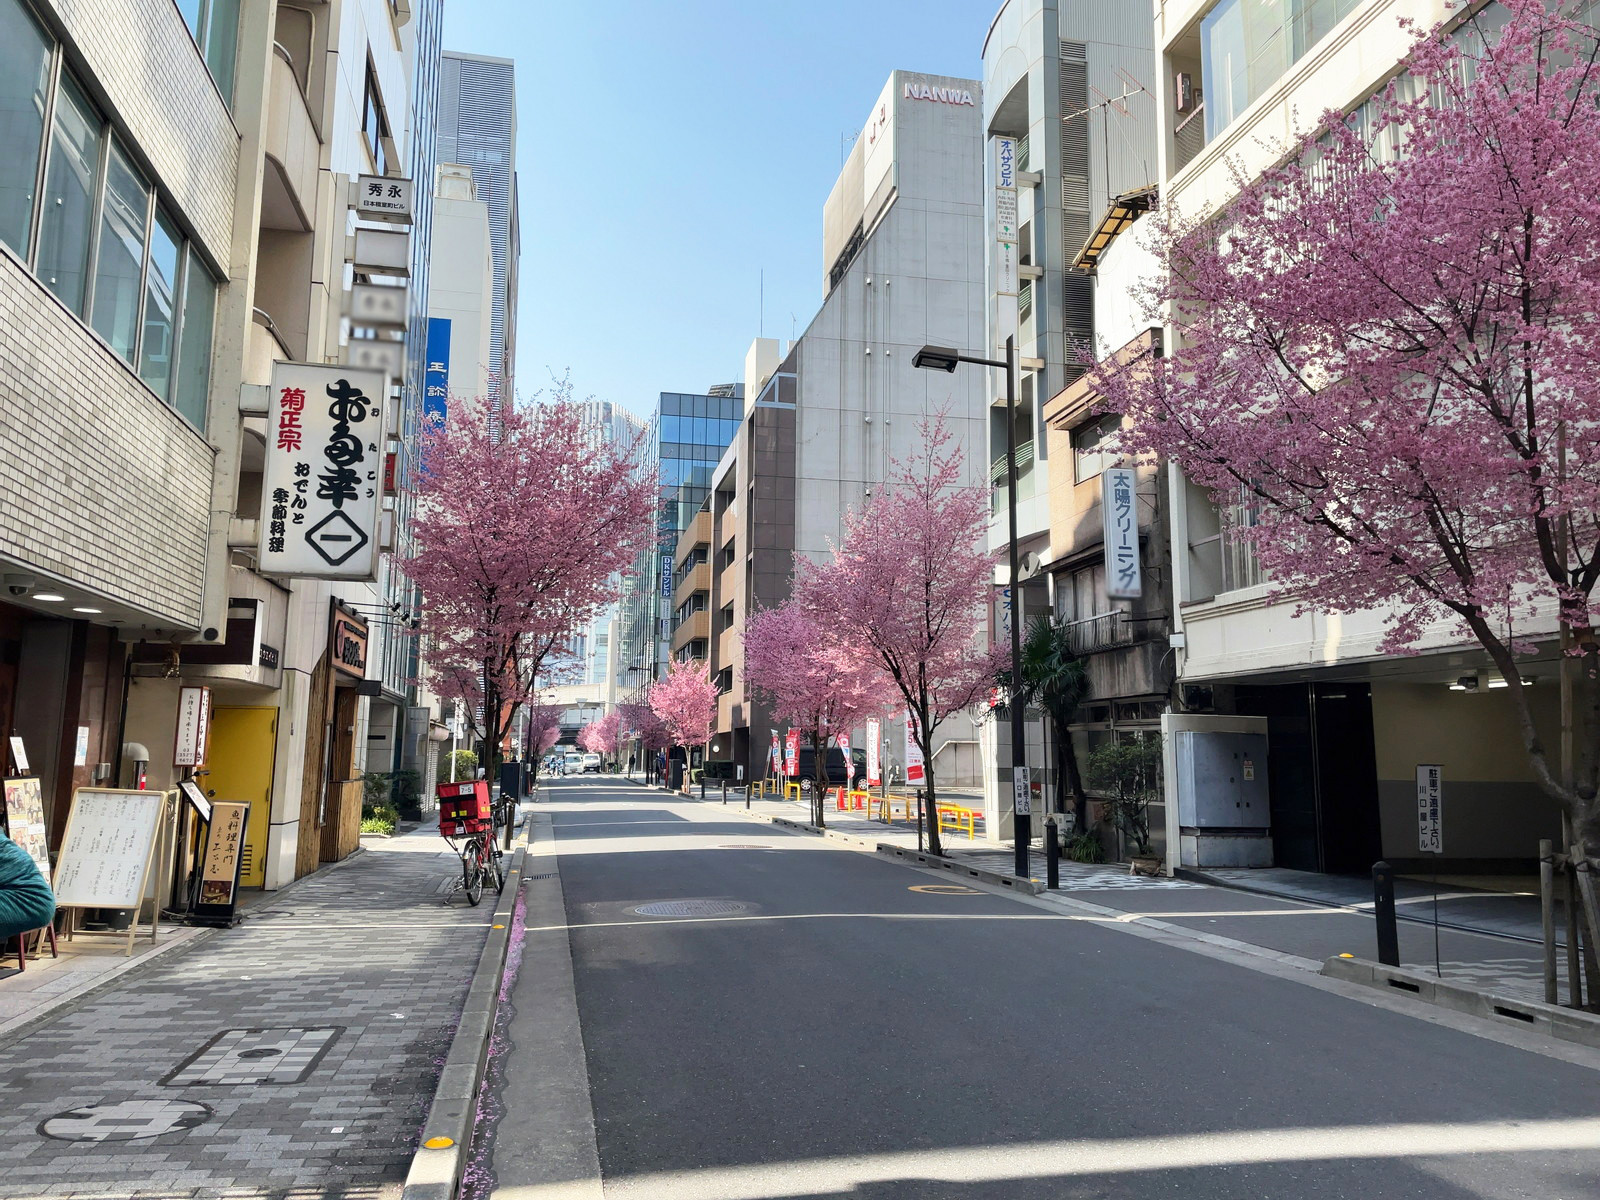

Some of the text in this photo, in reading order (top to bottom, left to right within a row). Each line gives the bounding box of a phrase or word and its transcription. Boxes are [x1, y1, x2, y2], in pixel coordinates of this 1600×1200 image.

[904, 82, 974, 107] NANWA
[368, 183, 402, 198] 秀永
[1001, 140, 1013, 187] オバザワビル
[363, 200, 405, 209] 日本橋室町ビル
[277, 387, 306, 453] 菊正宗
[316, 379, 371, 509] お多幸
[366, 408, 380, 498] おたこう
[268, 488, 290, 553] 季節料理
[291, 462, 310, 525] おでんと
[1113, 472, 1136, 589] 太陽クリーニング
[786, 741, 795, 776] OPEN
[222, 809, 240, 866] 魚料理専門
[1419, 785, 1428, 849] 川口屋ビル
